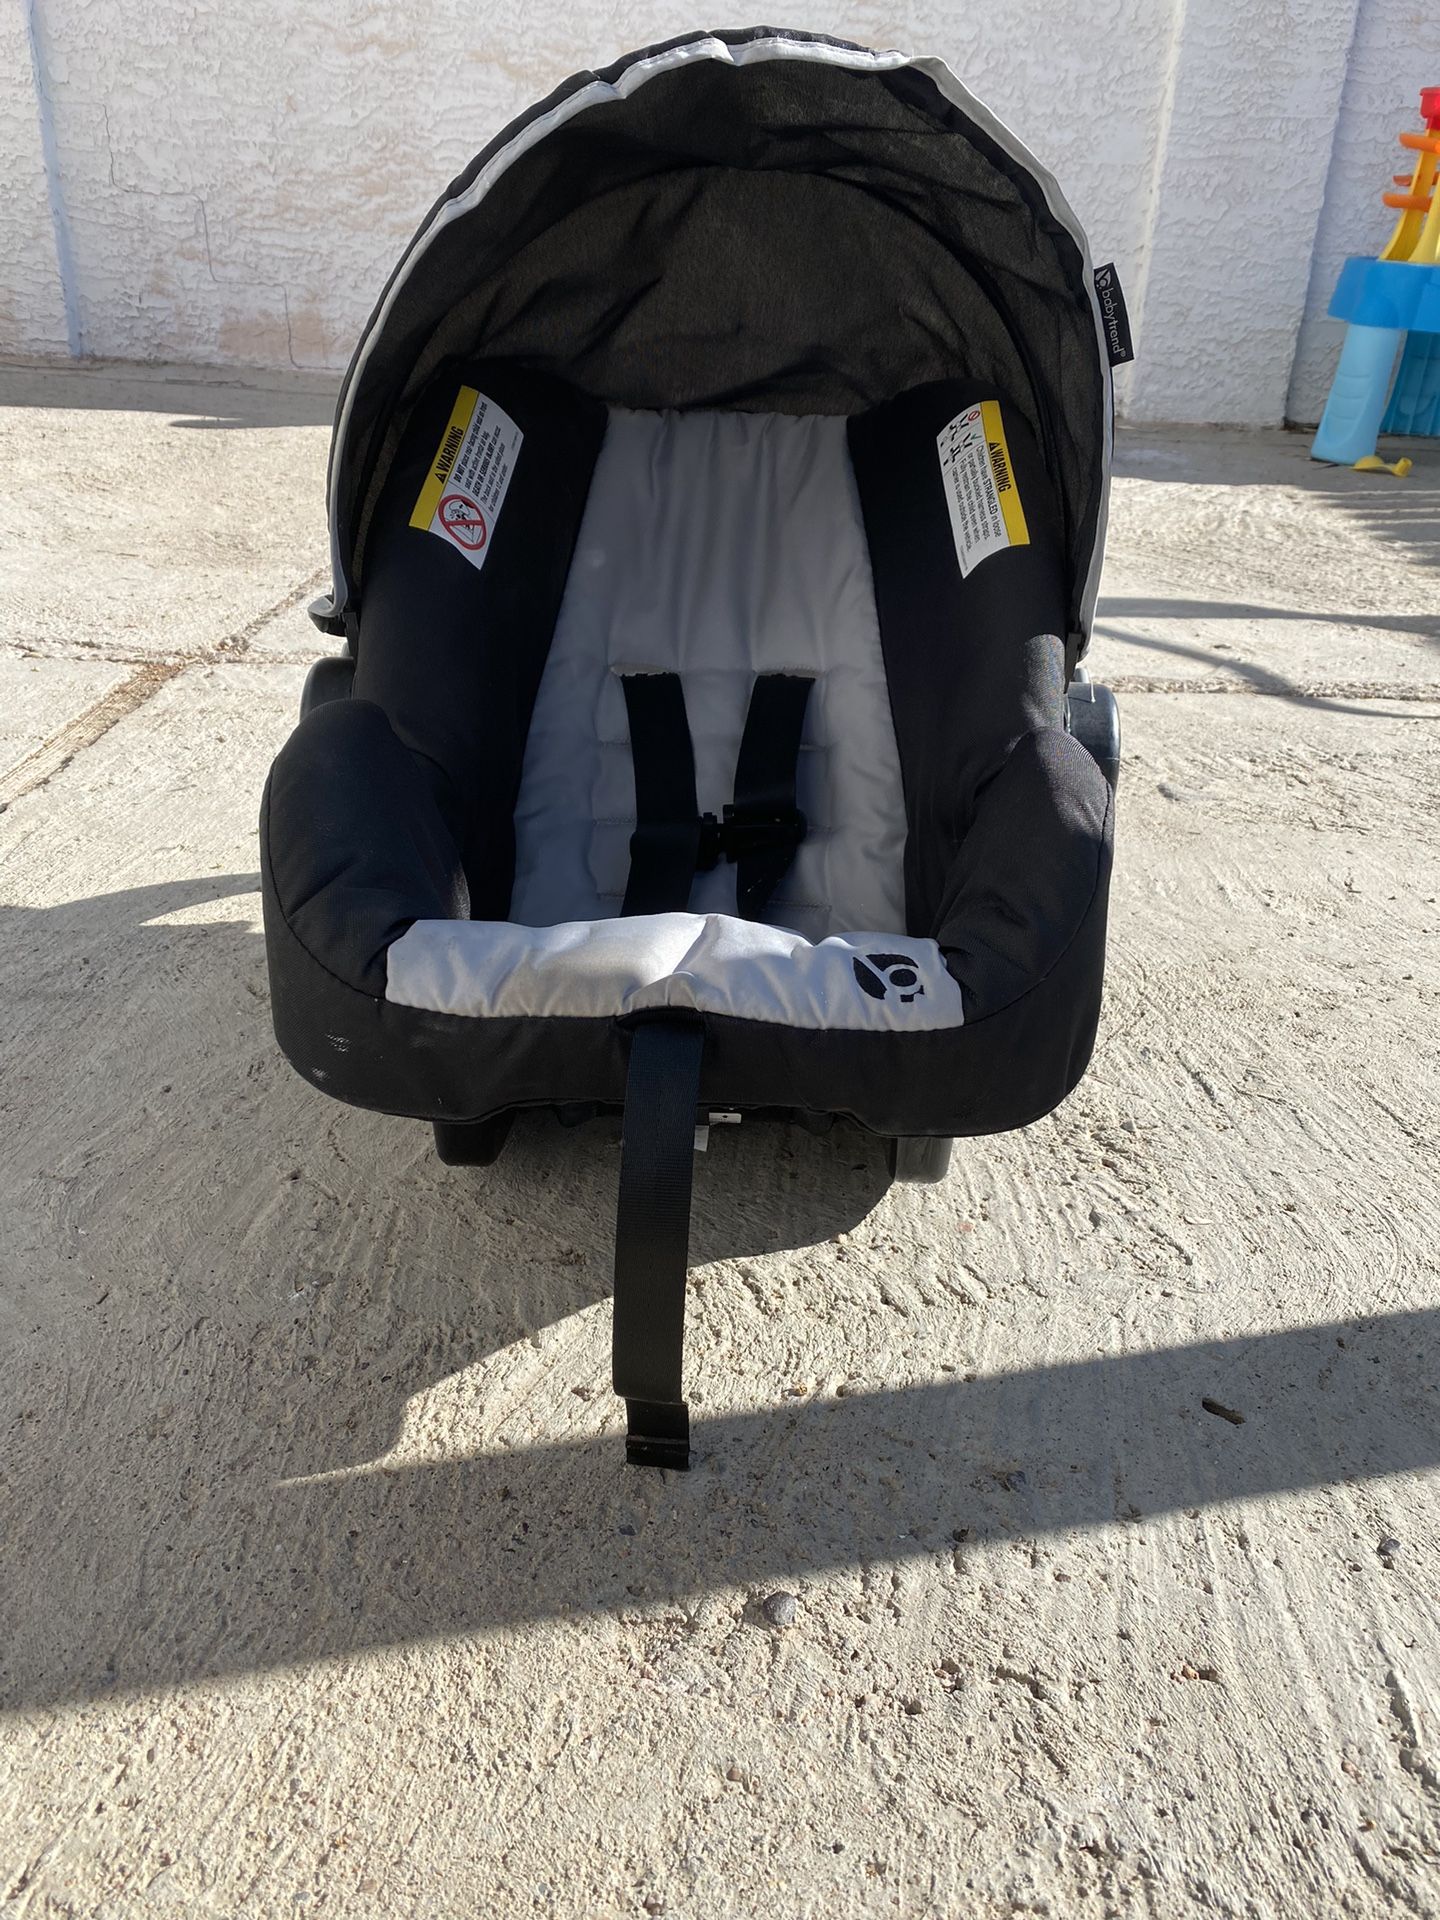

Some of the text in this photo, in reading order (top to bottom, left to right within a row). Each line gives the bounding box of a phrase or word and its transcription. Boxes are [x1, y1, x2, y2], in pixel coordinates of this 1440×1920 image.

[437, 426, 463, 472] WARNING
[456, 464, 465, 475] NOT
[461, 454, 469, 467] place
[465, 433, 478, 455] rear-facing
[472, 423, 480, 435] child
[976, 445, 985, 467] Children
[471, 457, 479, 470] active
[472, 481, 481, 496] DEATH
[479, 457, 489, 476] SERIOUS
[486, 442, 494, 459] INJURY
[967, 458, 978, 480] partially
[980, 465, 988, 480] have
[991, 449, 1010, 492] WARNING
[483, 484, 491, 496] back
[491, 488, 499, 506] children
[972, 477, 982, 500] buckled
[983, 478, 997, 514] STRANGLED
[959, 501, 967, 522] outside
[967, 500, 975, 514] child
[977, 498, 986, 521] harness
[992, 520, 1001, 537] loose
